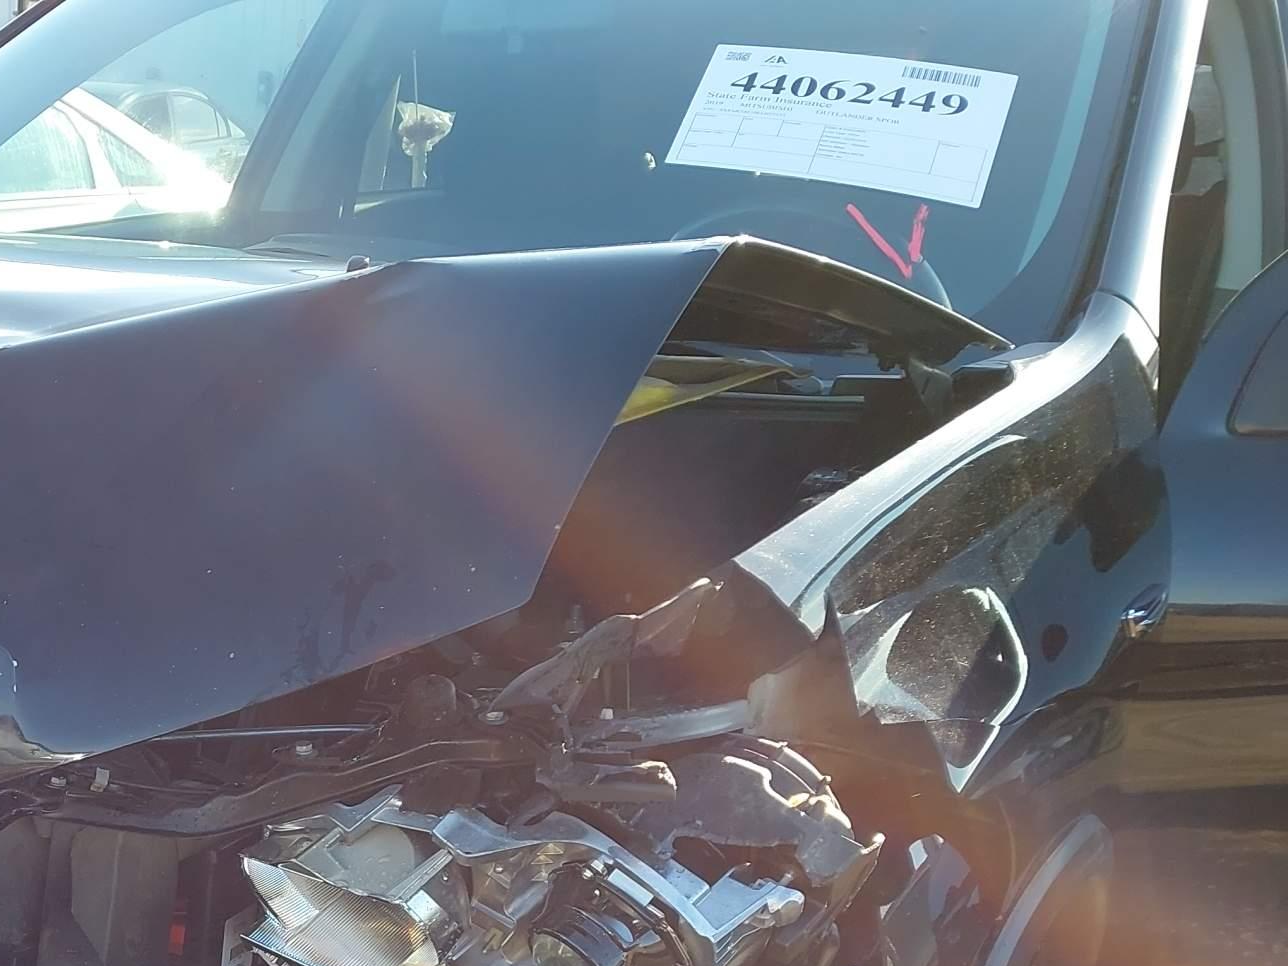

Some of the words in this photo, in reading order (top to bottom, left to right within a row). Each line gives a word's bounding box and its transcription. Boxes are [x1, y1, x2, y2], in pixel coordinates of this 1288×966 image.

[707, 91, 736, 101] State
[740, 93, 772, 104] Farm
[775, 96, 833, 109] Insurance
[730, 71, 969, 116] 44062449
